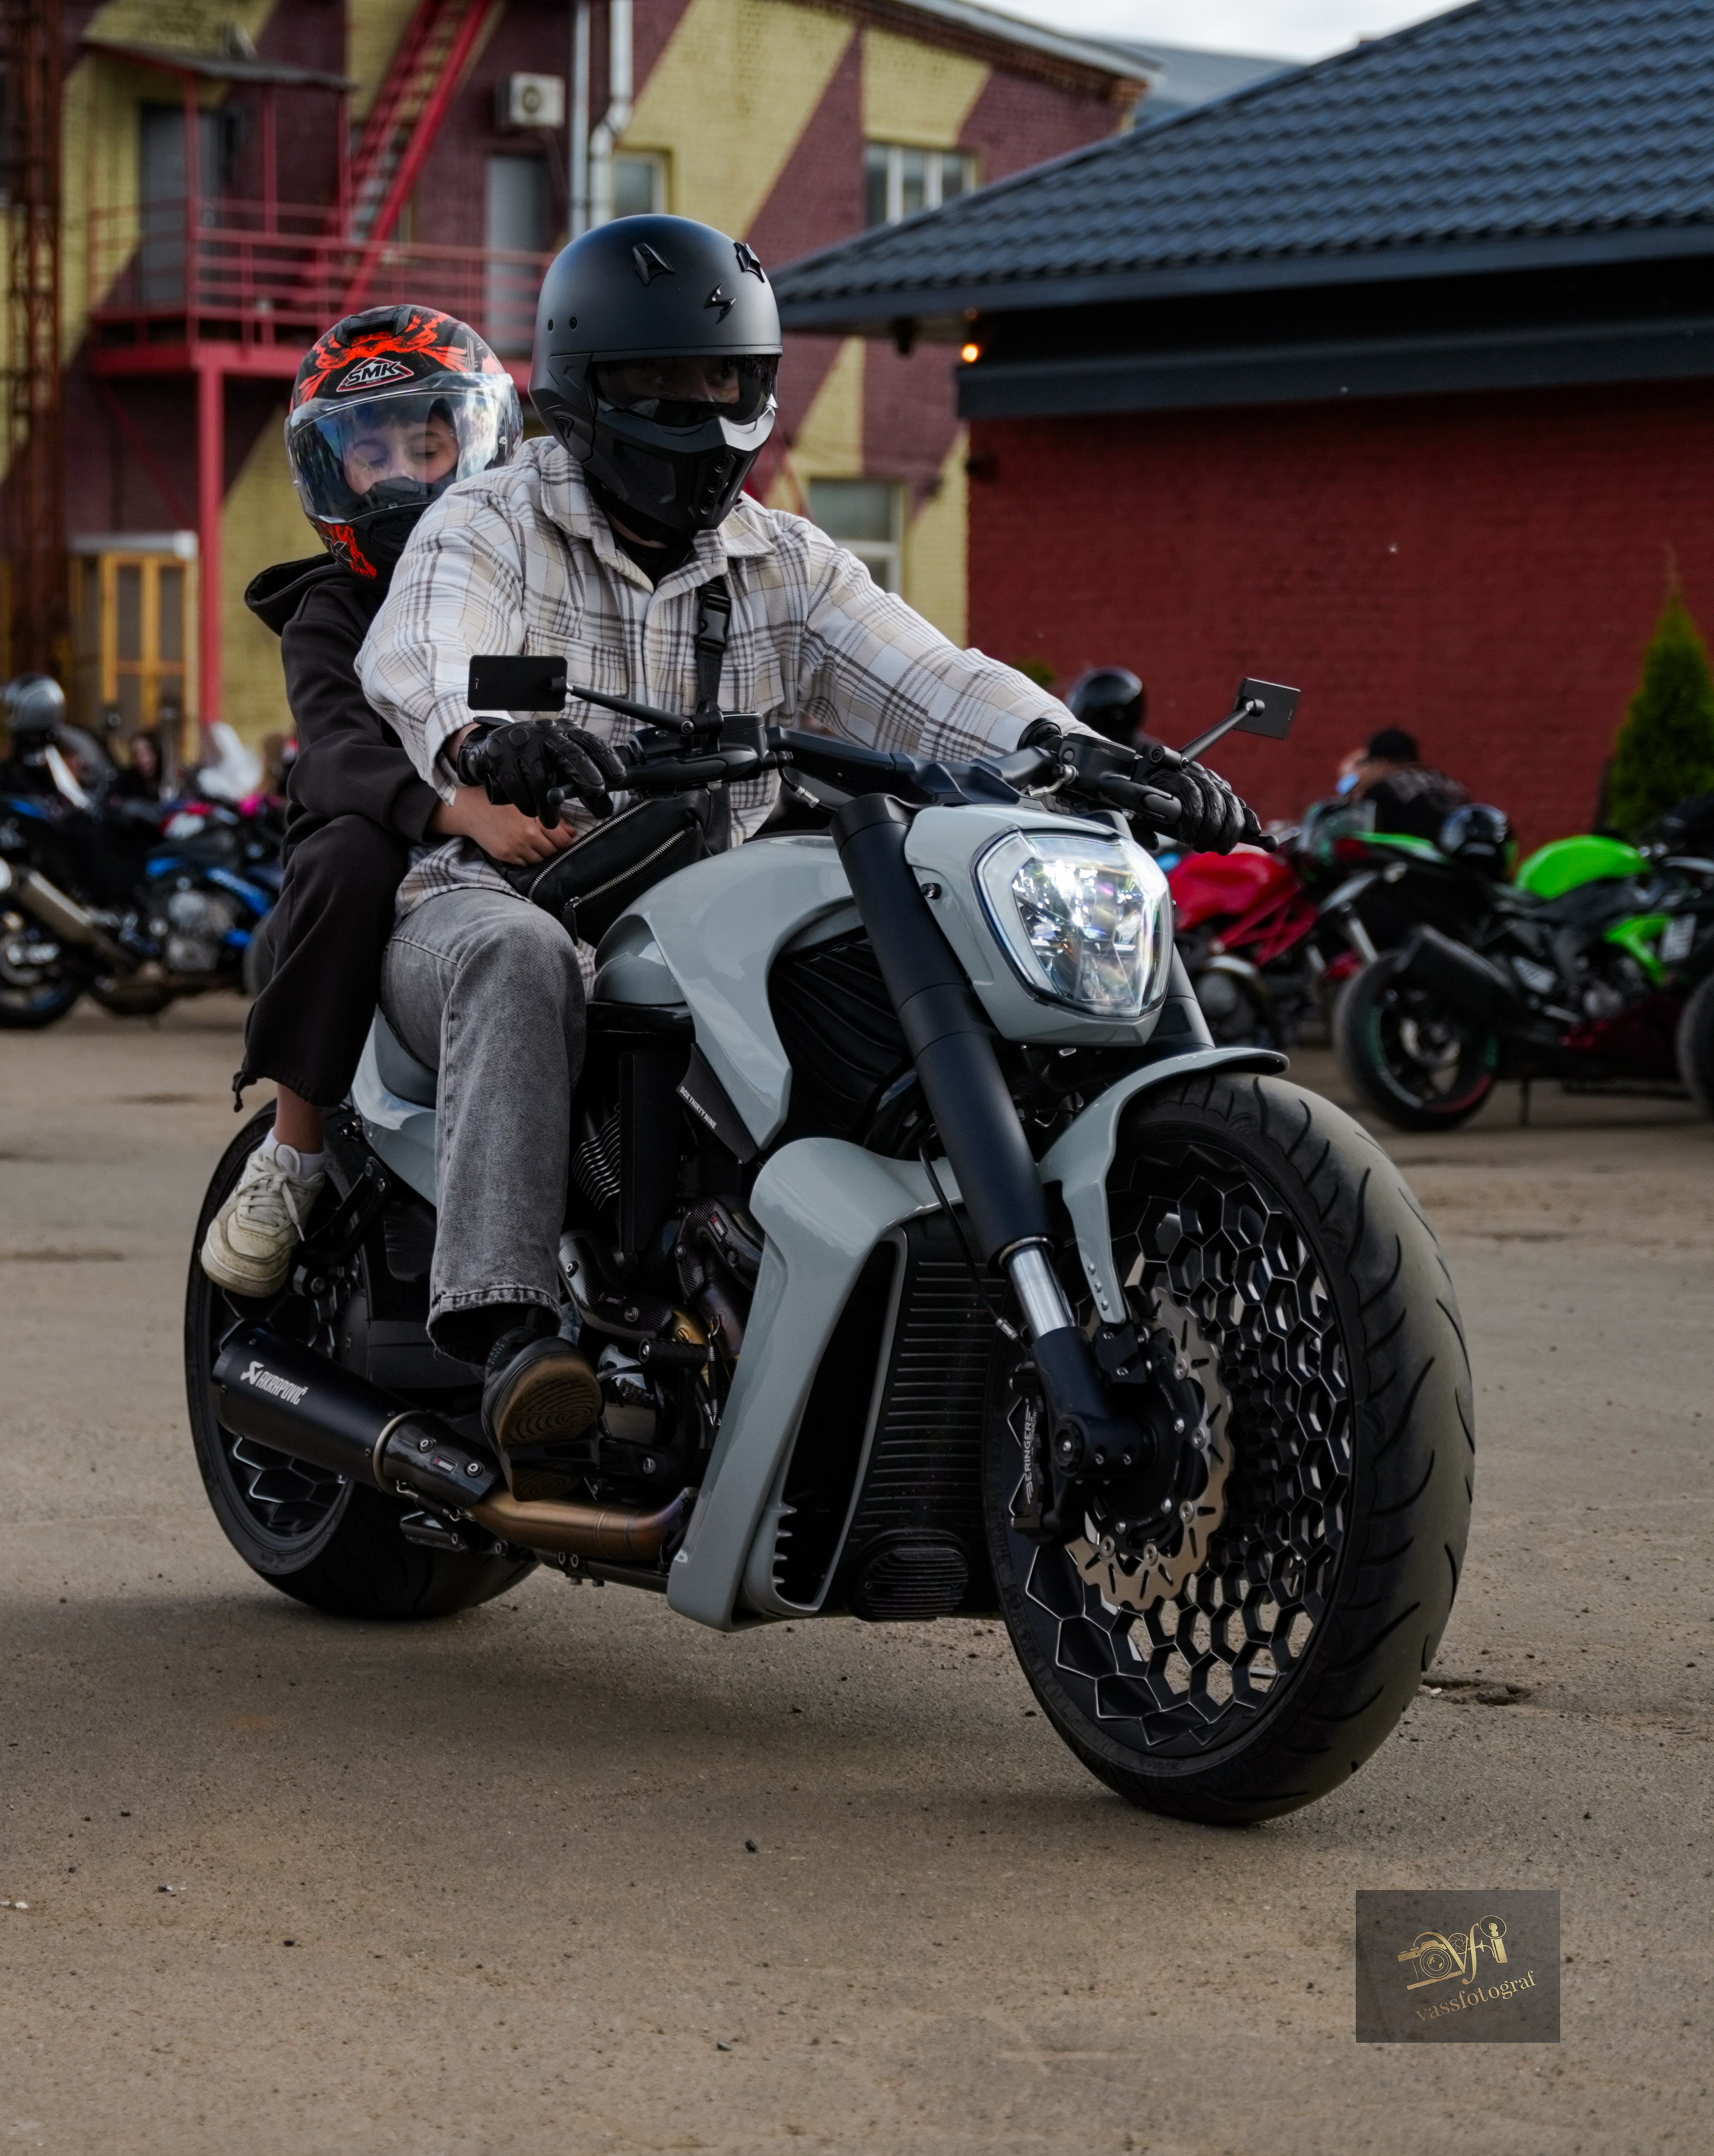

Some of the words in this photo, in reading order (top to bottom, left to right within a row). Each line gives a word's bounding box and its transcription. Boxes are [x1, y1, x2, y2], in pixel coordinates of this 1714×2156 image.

[346, 361, 400, 386] SMK
[680, 1086, 690, 1100] BOX
[689, 1096, 706, 1116] THIRTY
[704, 1113, 717, 1129] NINE
[1024, 1405, 1034, 1505] BERINGER
